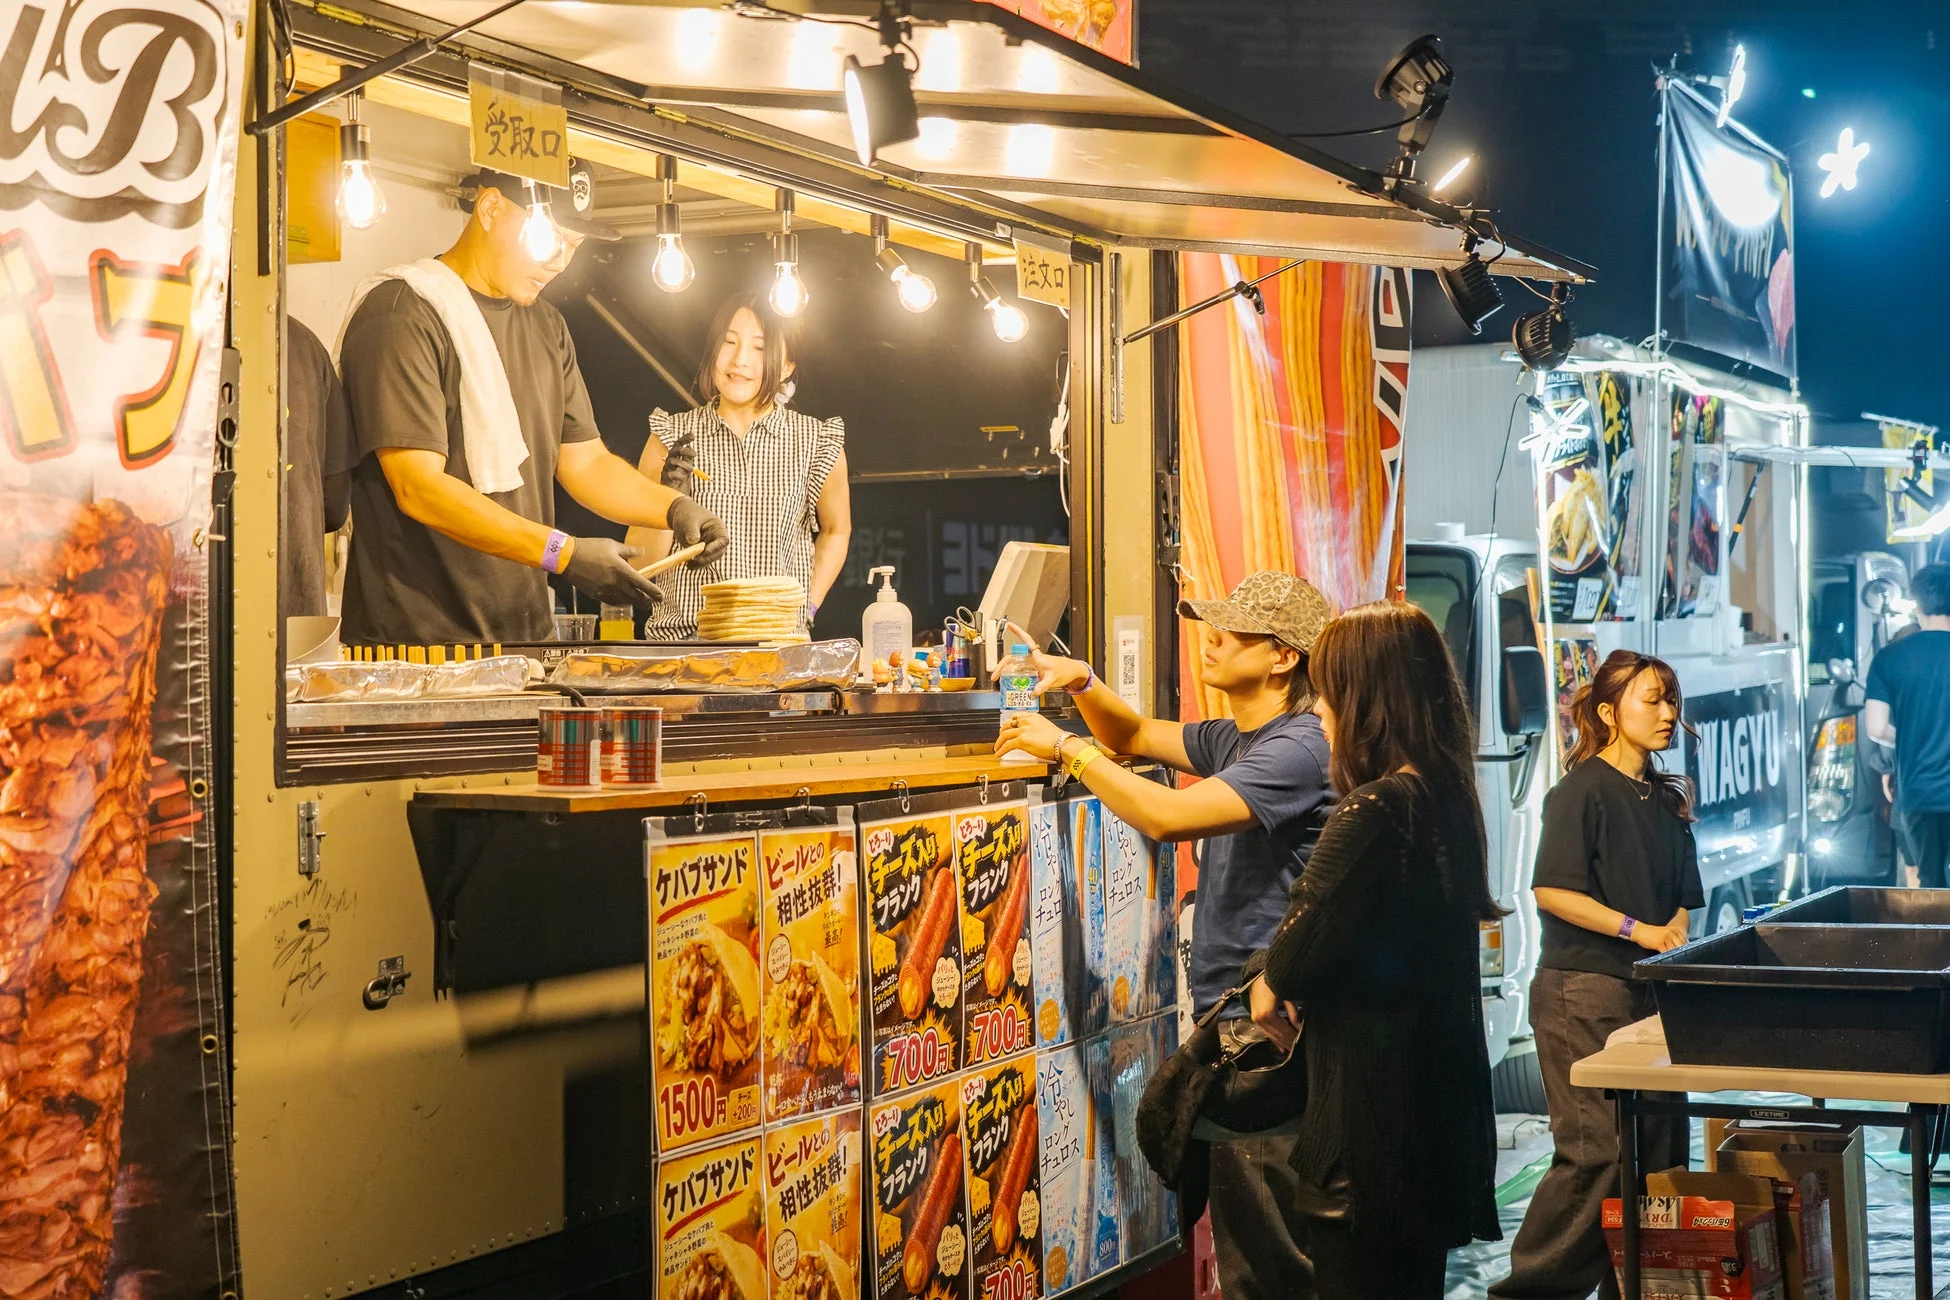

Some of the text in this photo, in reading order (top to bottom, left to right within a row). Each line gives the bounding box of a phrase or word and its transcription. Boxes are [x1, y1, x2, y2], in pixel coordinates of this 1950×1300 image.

[485, 97, 561, 160] 受取口
[1022, 252, 1065, 290] 注文口
[1694, 708, 1780, 808] WAGYU
[655, 847, 748, 907] ケバブサンド
[765, 841, 825, 891] ビールとの
[871, 833, 938, 896] チーズ入り
[963, 821, 1022, 880] チーズ入り
[776, 864, 842, 928] 相性抜群!
[877, 874, 921, 926] フランク
[967, 860, 1009, 908] フランク
[1109, 876, 1142, 908] チュロス
[888, 1027, 949, 1088] 700円
[974, 1005, 1026, 1061] 700円
[660, 1076, 727, 1139] 1500円
[967, 1077, 1023, 1140] チーズ入り
[1039, 1060, 1075, 1121] 冷やし
[767, 1129, 830, 1188] ビールとの
[878, 1101, 944, 1175] チーズ入り
[973, 1115, 1009, 1169] フランク
[1041, 1137, 1080, 1177] チュロス
[1045, 1121, 1070, 1150] ロング
[663, 1146, 754, 1222] ケバブサンド
[779, 1145, 847, 1223] 相性抜群!
[883, 1147, 927, 1206] フランク
[1645, 1213, 1670, 1223] DRY
[985, 1260, 1034, 1300] 700円
